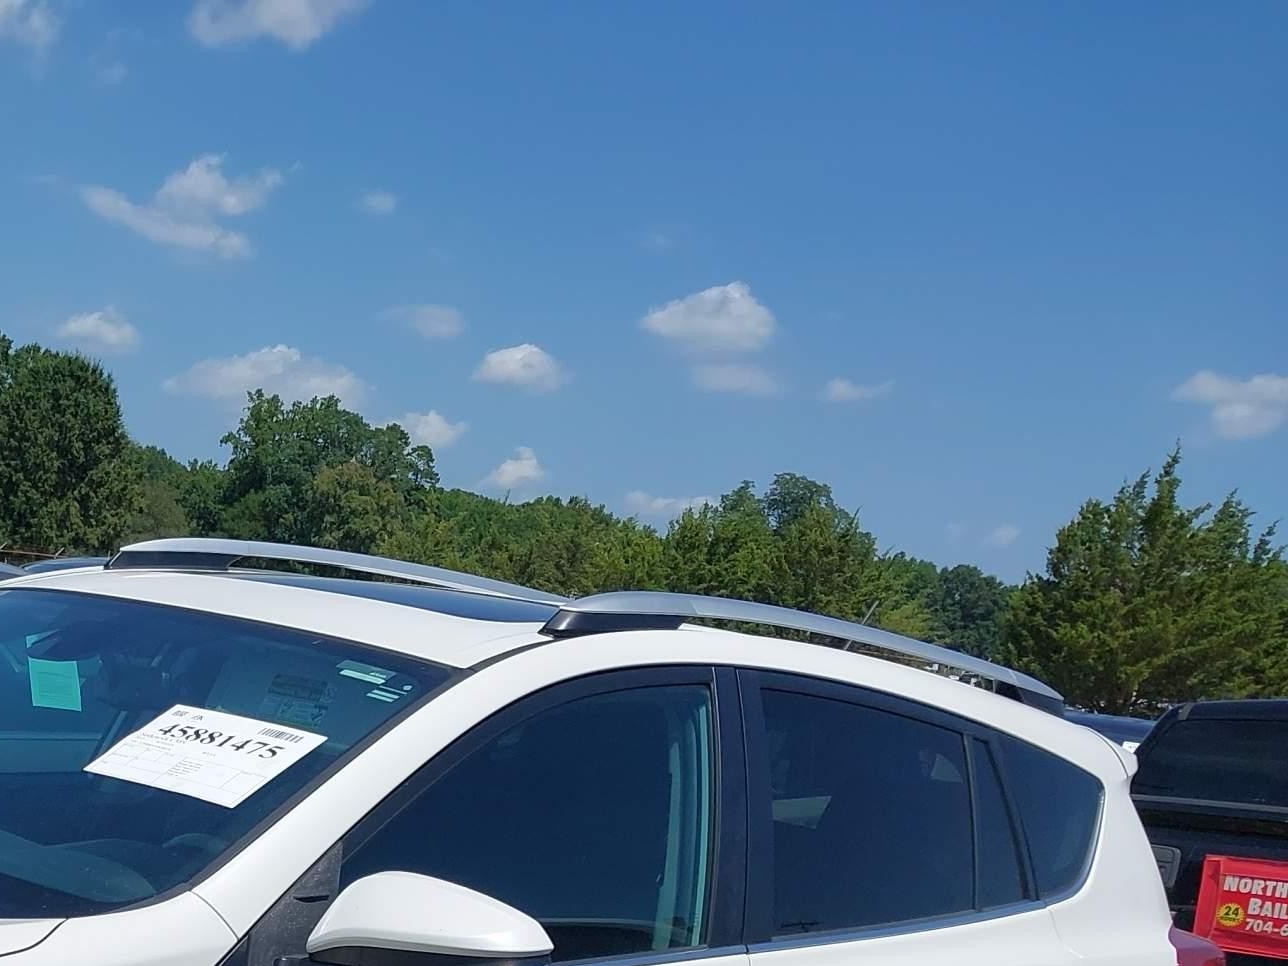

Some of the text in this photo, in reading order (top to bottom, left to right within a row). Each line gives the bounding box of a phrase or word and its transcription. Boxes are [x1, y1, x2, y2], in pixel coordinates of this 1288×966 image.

[158, 722, 286, 760] 45881475
[1223, 876, 1288, 899] NORTH
[1223, 905, 1240, 917] 24
